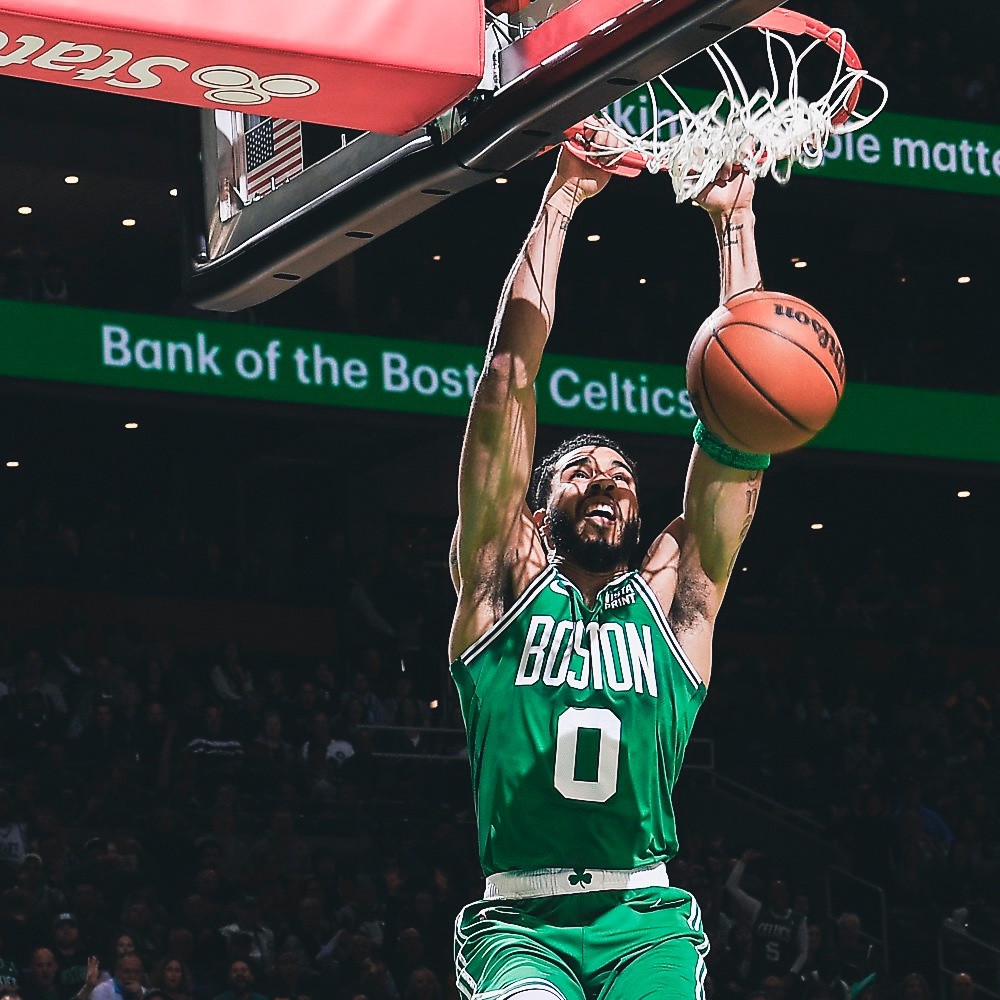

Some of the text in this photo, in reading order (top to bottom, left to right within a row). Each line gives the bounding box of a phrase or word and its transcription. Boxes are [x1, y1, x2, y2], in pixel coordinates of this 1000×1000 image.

[102, 325, 696, 418] Bank of the Bost Celtics
[515, 614, 659, 698] BOSTON
[553, 706, 622, 803] 0
